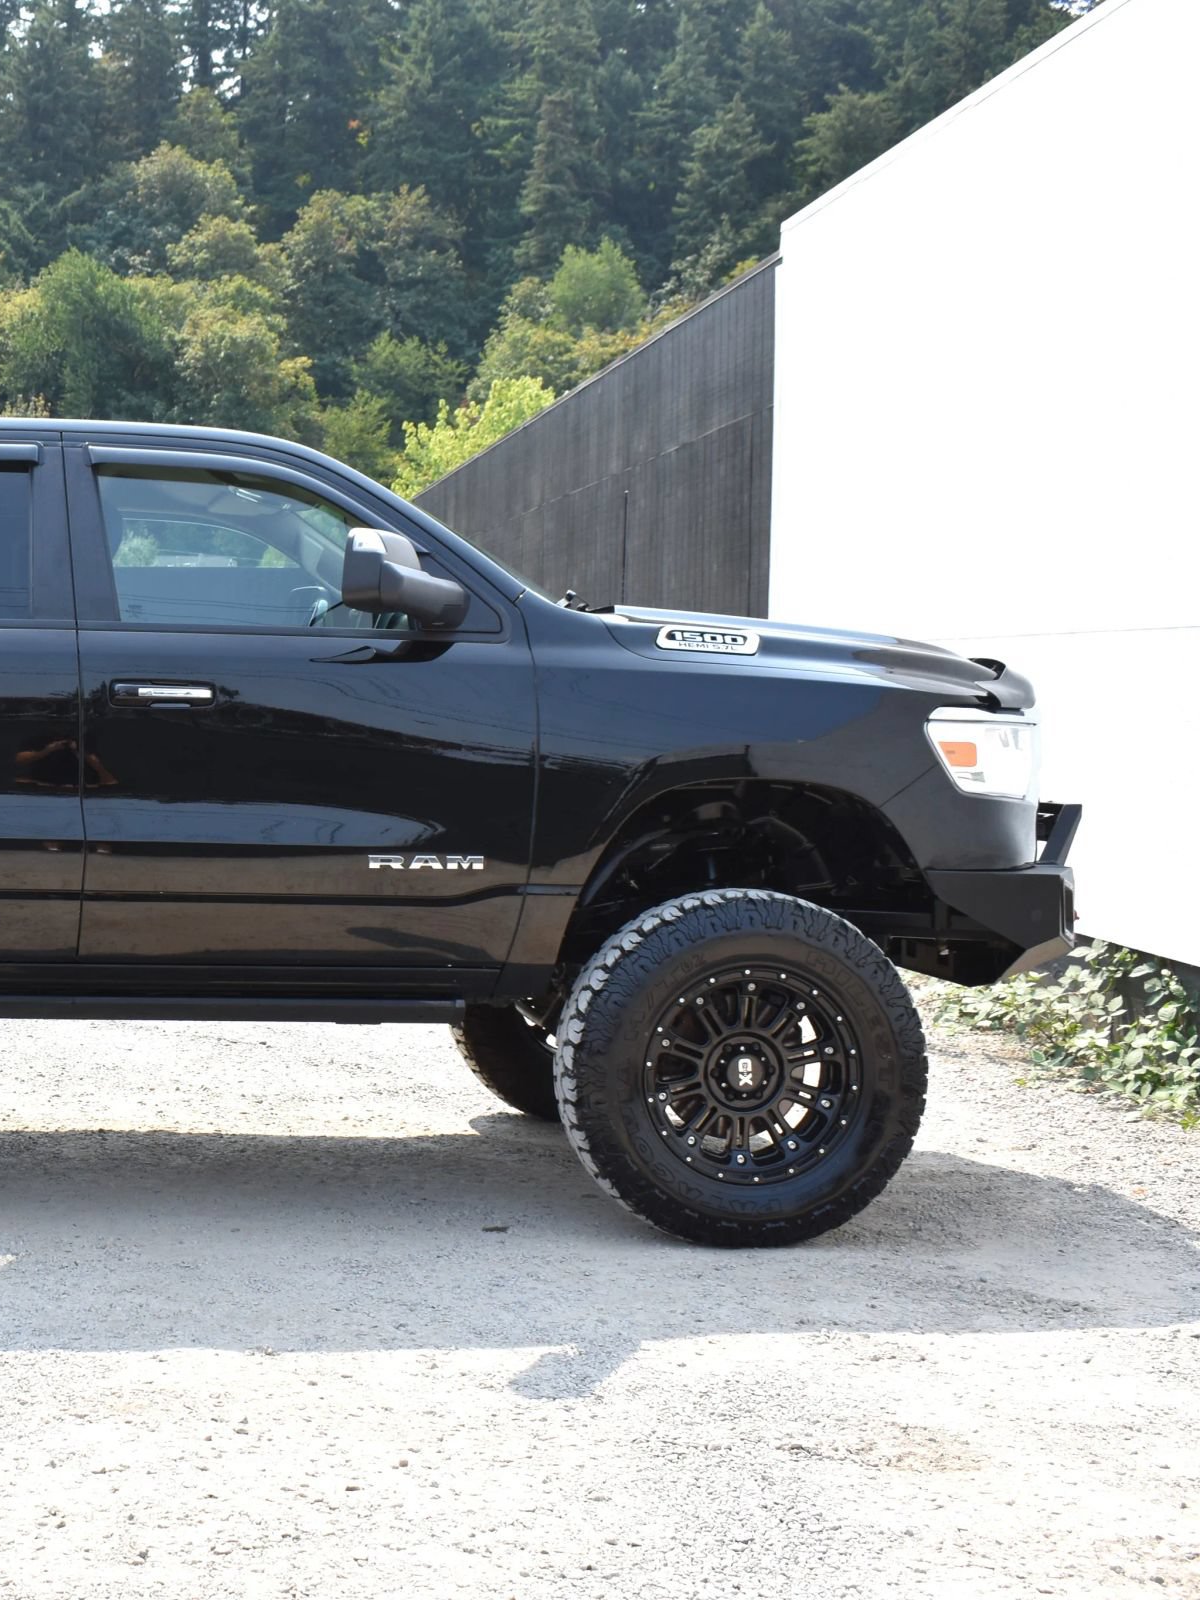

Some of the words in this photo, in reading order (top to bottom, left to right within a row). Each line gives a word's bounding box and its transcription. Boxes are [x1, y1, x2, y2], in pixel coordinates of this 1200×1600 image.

[671, 631, 746, 645] 1500
[679, 641, 709, 649] HEMI
[367, 854, 485, 870] RAM
